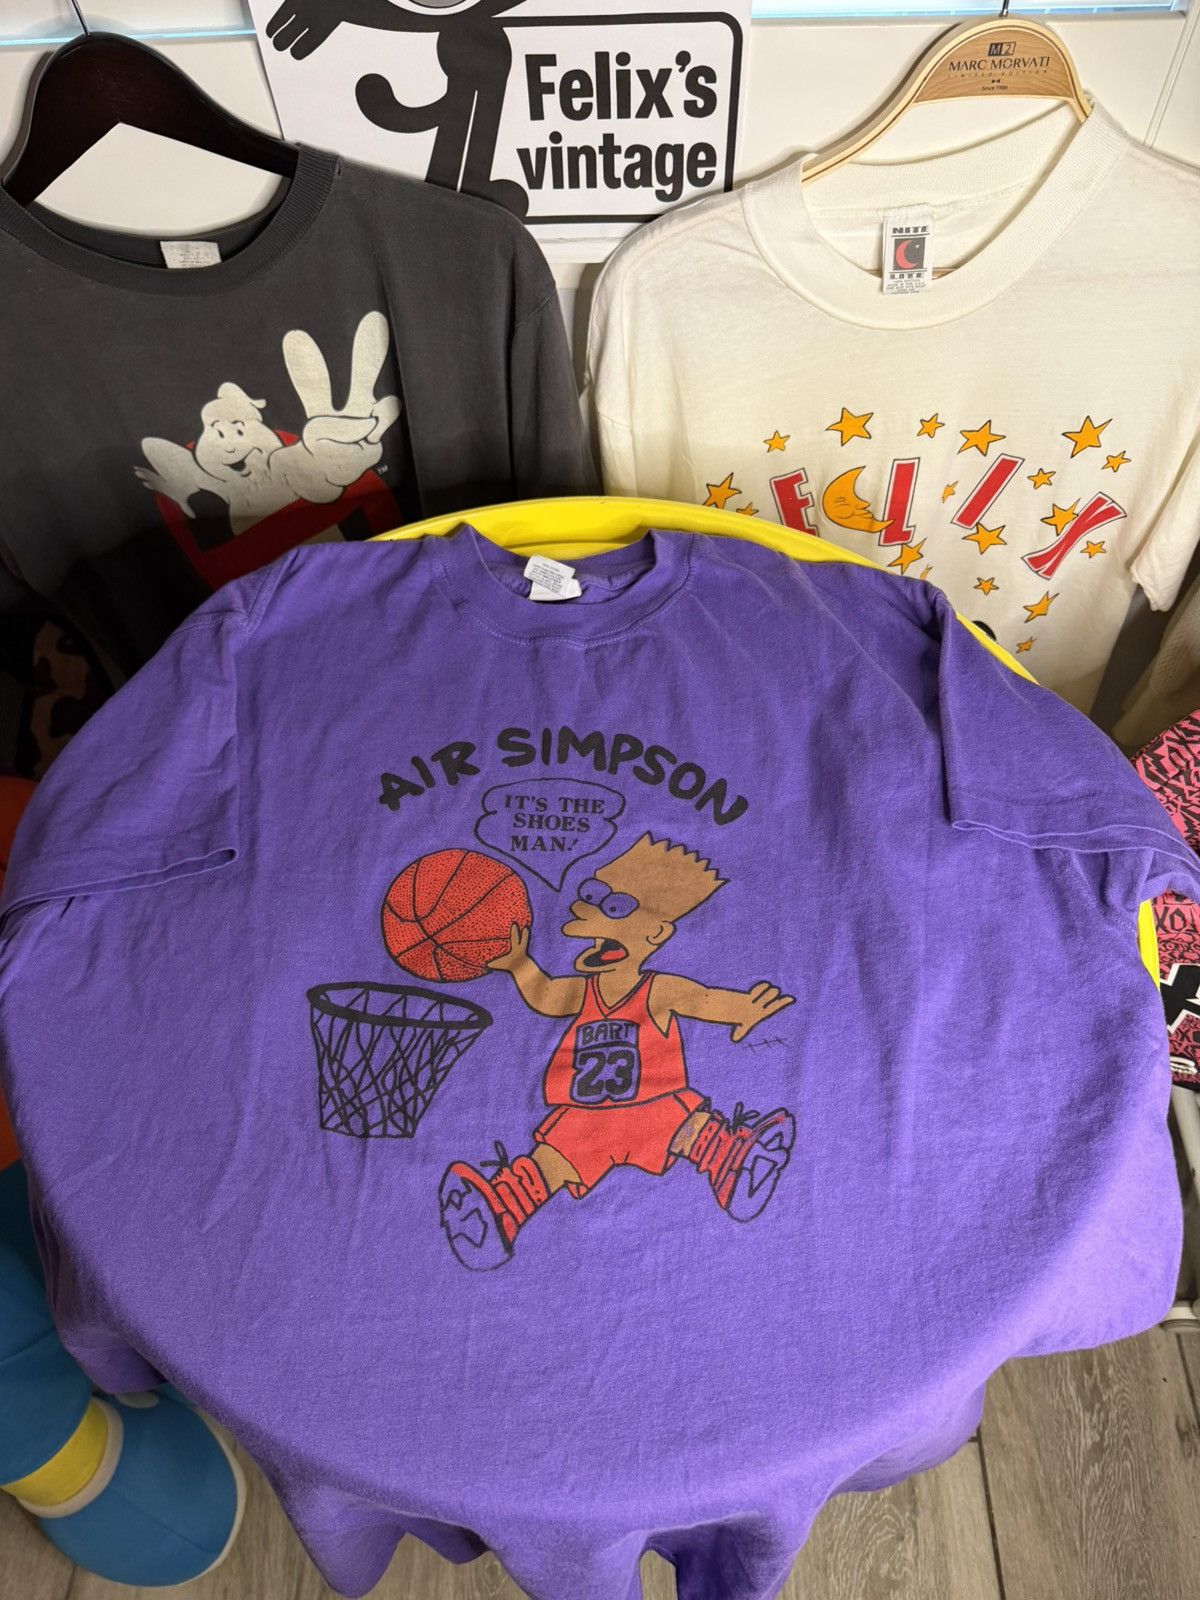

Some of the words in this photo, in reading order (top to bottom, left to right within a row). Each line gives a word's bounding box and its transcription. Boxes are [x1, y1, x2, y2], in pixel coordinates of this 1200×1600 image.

[948, 59, 987, 72] MARC
[990, 56, 1050, 70] MORVATI
[525, 50, 717, 121] Felix's
[516, 131, 717, 202] vintage
[892, 225, 929, 234] NITE
[379, 741, 480, 812] AIR
[497, 725, 749, 826] SIMPSON
[504, 794, 548, 812] IT'S
[559, 797, 605, 814] THE
[513, 813, 591, 833] SHOES
[510, 835, 579, 852] MAN!
[581, 1022, 630, 1046] BART
[576, 1050, 635, 1097] 23
